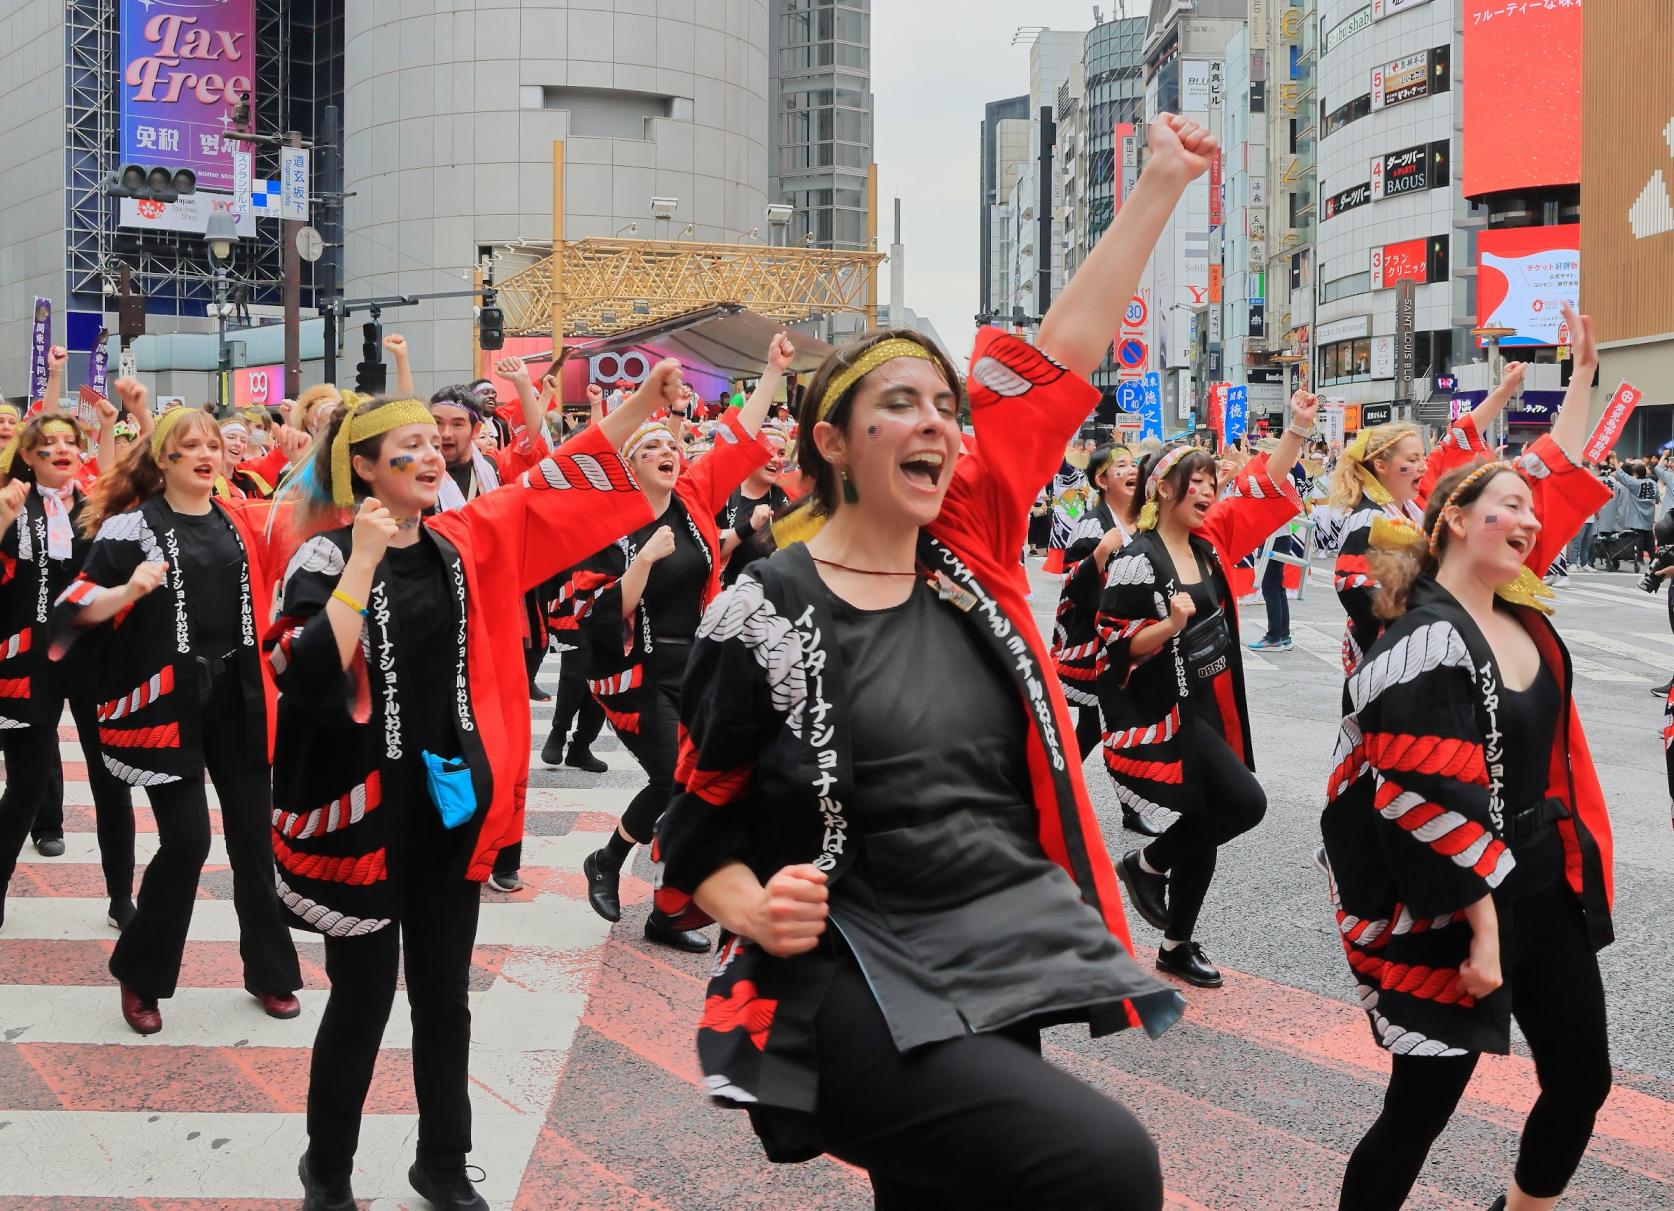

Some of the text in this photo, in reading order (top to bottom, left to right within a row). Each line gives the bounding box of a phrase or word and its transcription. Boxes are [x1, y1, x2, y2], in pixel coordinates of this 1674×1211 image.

[144, 14, 245, 61] Tax
[126, 57, 252, 105] Free
[1188, 77, 1209, 86] BLU
[136, 125, 179, 152] 免税
[1387, 150, 1425, 170] ダーツバー
[293, 155, 305, 213] 道玄坂下
[1387, 173, 1425, 193] BAGUS
[1388, 262, 1426, 277] クリニック
[1127, 305, 1142, 319] 30
[1404, 299, 1412, 382] SAINT LOUIS BLD
[1123, 389, 1135, 409] P
[165, 528, 190, 654] インターナショナルおはら
[451, 558, 474, 732] インターナショナルおはら
[371, 580, 403, 760] インターナショナルおはら
[795, 604, 848, 871] インターナショナルおはら
[1479, 661, 1505, 837] インターナショナルお
